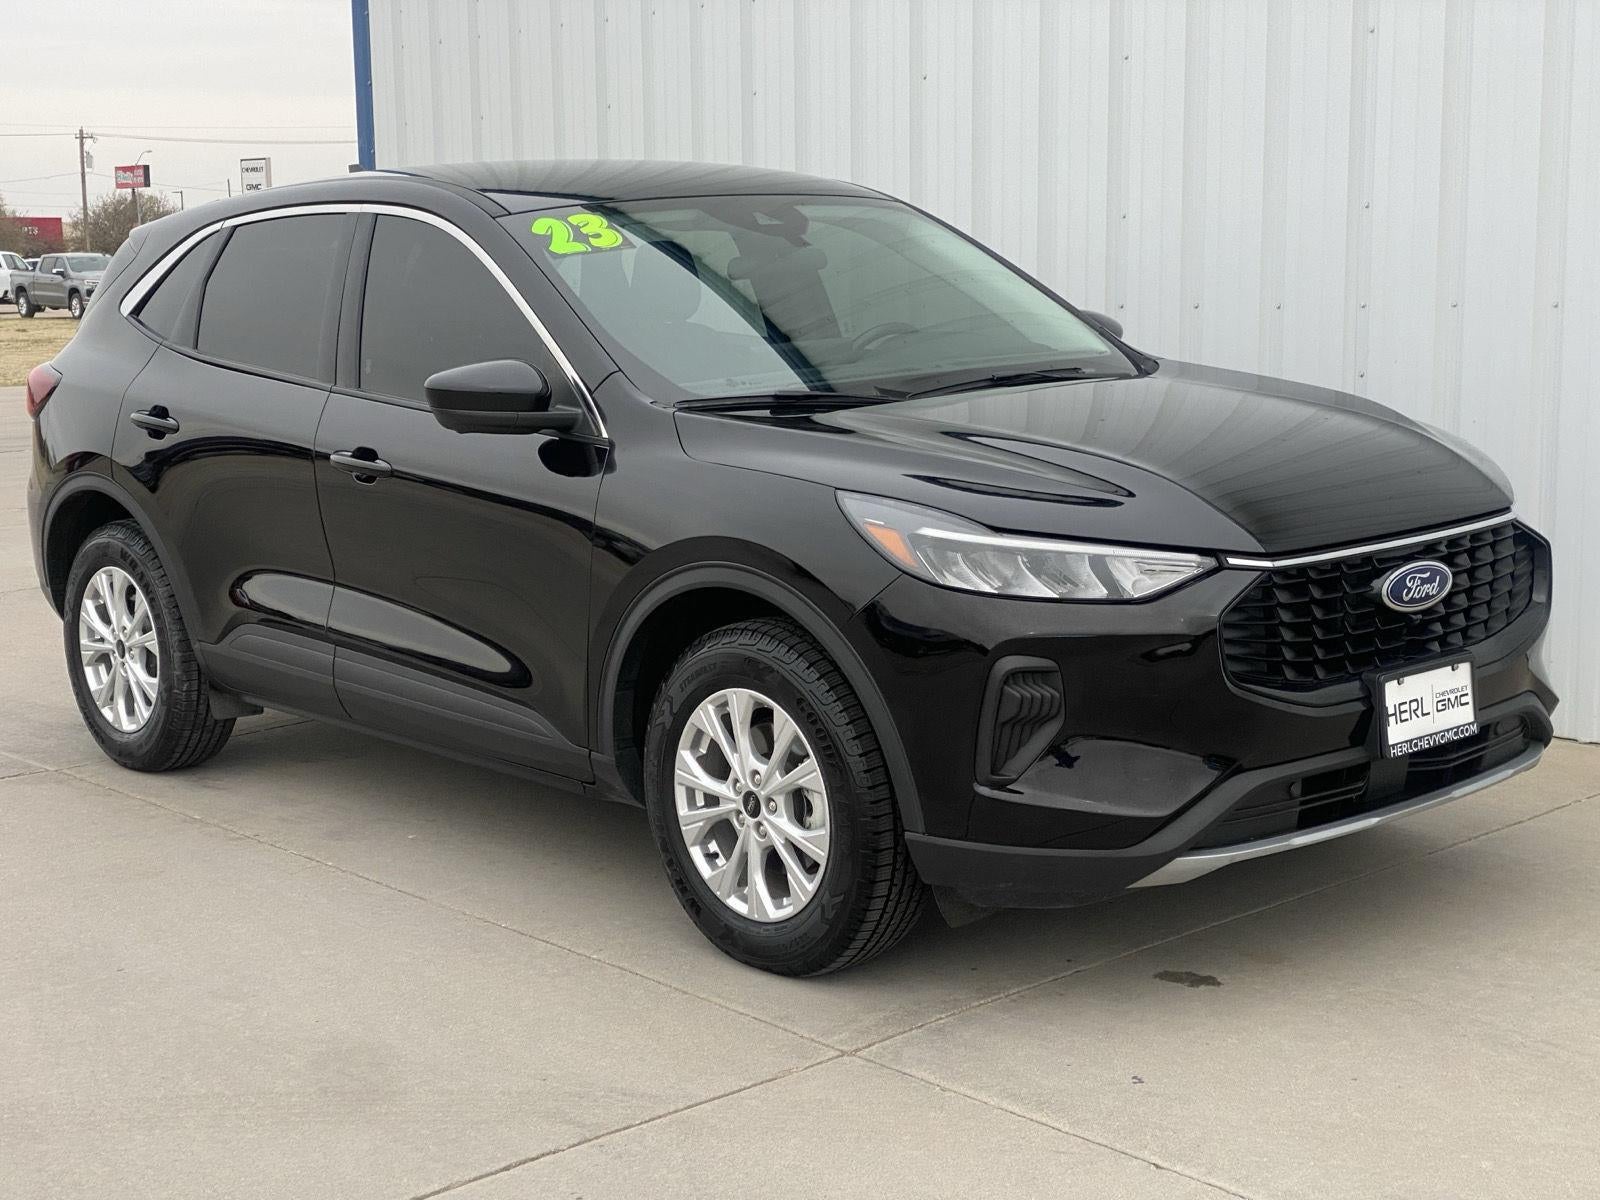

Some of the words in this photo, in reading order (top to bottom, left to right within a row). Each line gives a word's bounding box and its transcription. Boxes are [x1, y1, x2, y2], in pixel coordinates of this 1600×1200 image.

[245, 183, 262, 191] GMC
[531, 213, 623, 254] 23
[1402, 572, 1440, 602] Ford
[1435, 685, 1469, 699] CHEVROLET
[1386, 696, 1431, 727] HERL
[1435, 692, 1470, 713] GMC
[1390, 723, 1478, 758] HERLCHEVYGMC.COM
